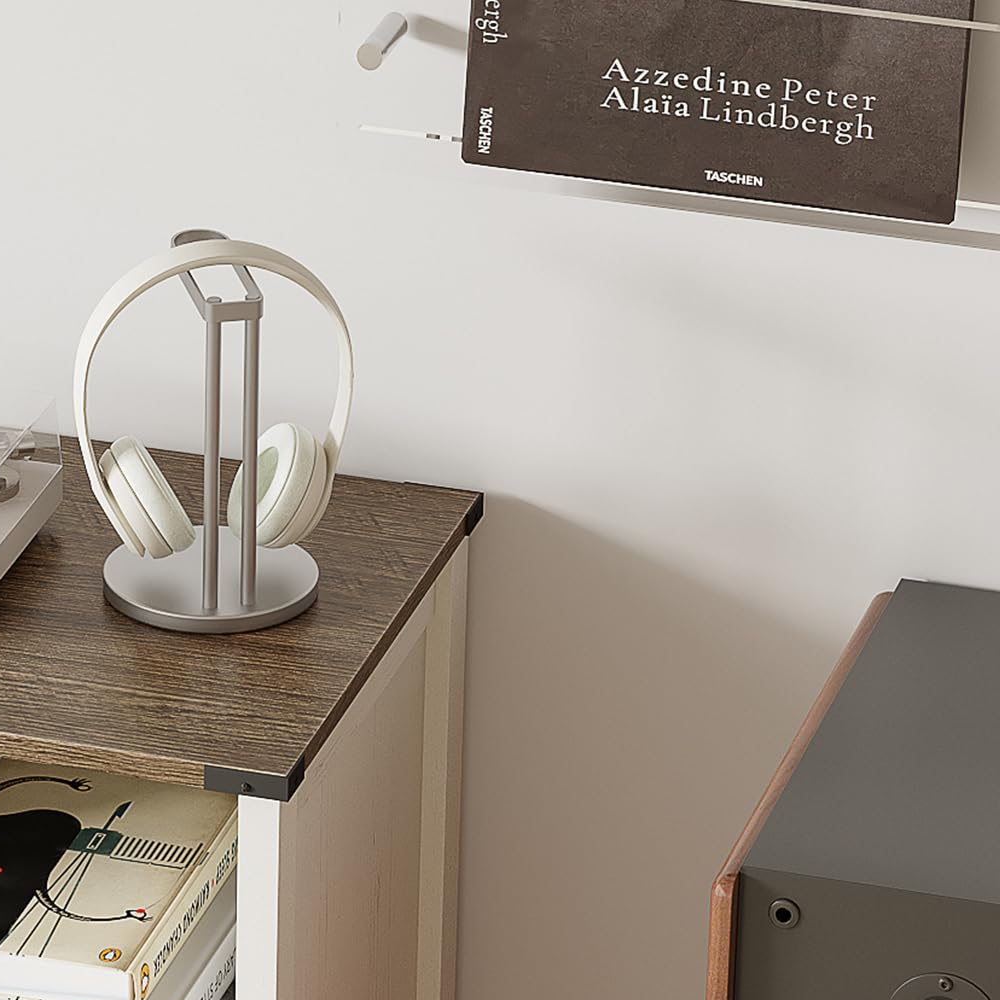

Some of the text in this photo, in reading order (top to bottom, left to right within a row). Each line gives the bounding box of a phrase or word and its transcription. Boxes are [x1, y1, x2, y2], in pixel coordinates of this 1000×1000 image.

[475, 0, 508, 44] ergh
[602, 58, 878, 112] Azzedine Peter
[477, 106, 495, 155] TASCHEN
[600, 85, 876, 145] Alaïa Lindbergh
[704, 169, 764, 187] TASCHEN
[153, 923, 183, 978] CHANDLER
